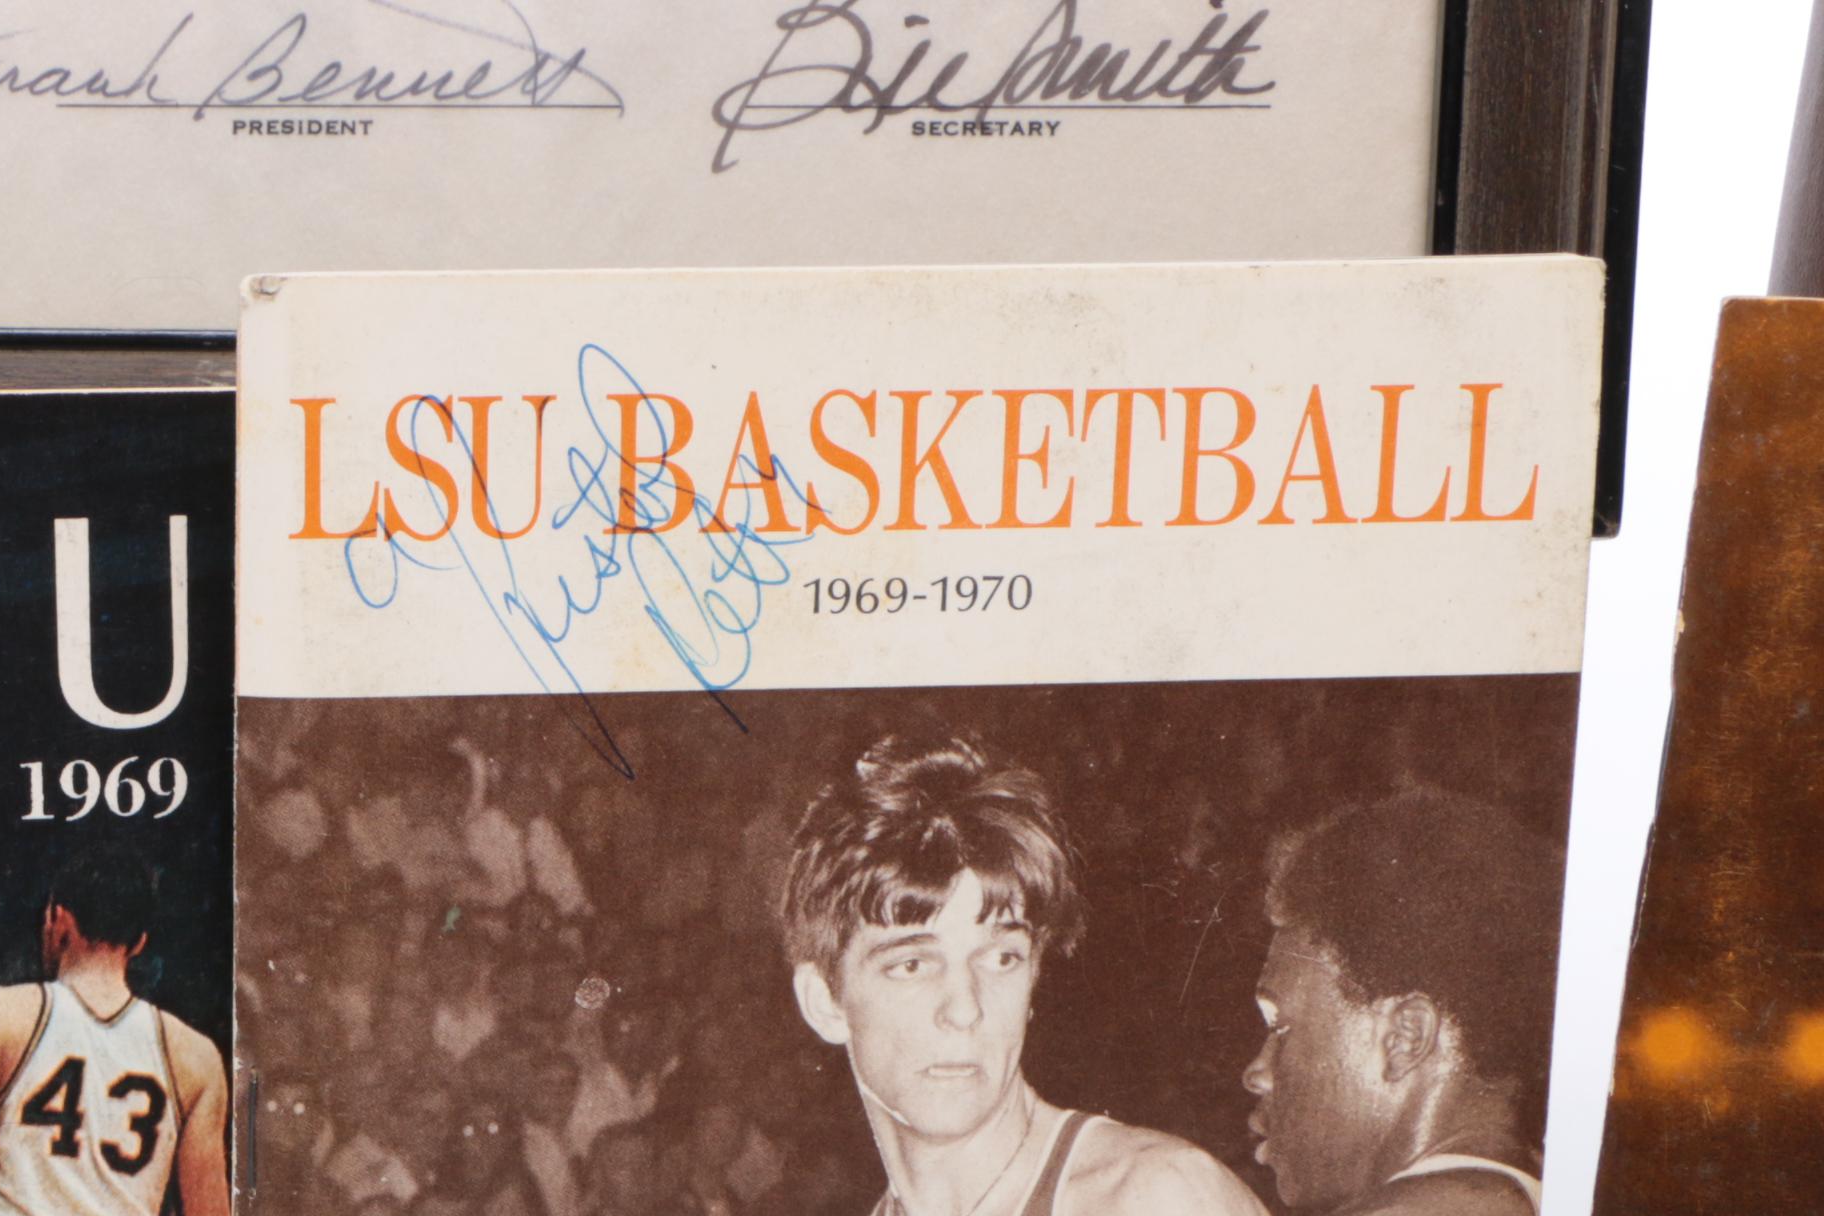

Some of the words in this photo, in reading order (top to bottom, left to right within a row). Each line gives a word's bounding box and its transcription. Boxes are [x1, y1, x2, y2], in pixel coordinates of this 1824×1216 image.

[231, 118, 375, 137] PRESIDENT
[910, 118, 1061, 138] SECRETARY
[288, 394, 558, 542] LSU
[602, 382, 1542, 537] BASKETBALL
[802, 573, 1034, 615] 1969-1970
[19, 756, 189, 822] 1969
[19, 1056, 167, 1177] 43
